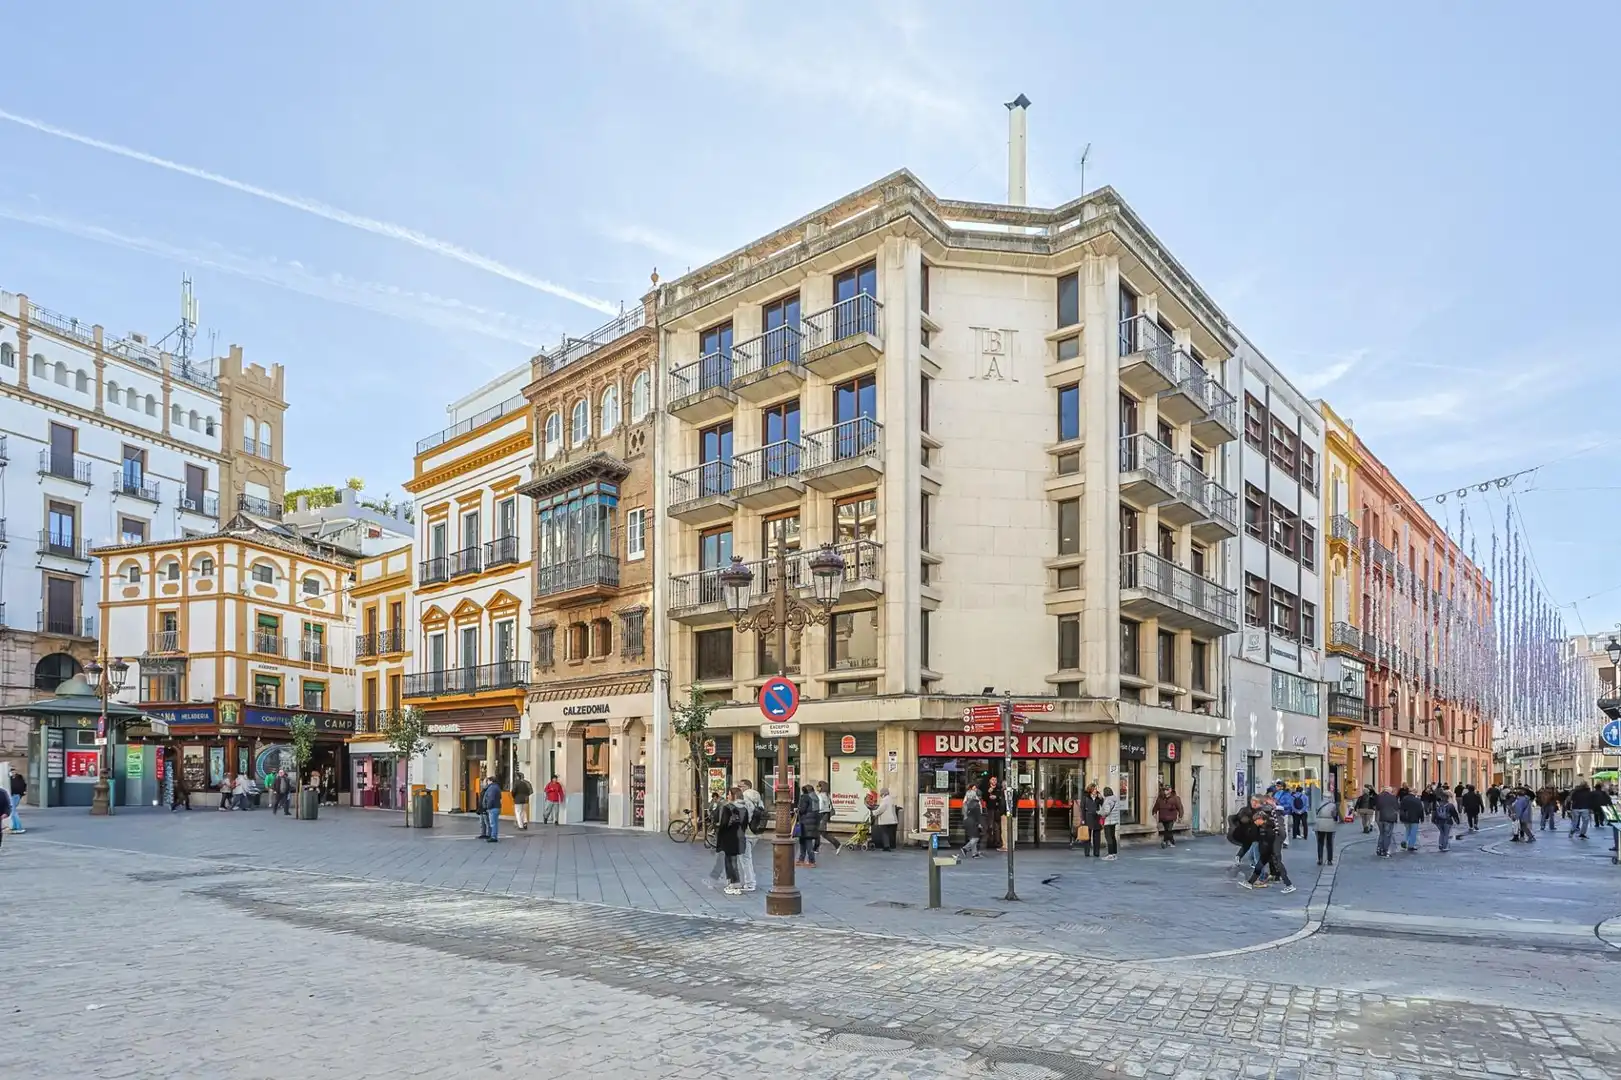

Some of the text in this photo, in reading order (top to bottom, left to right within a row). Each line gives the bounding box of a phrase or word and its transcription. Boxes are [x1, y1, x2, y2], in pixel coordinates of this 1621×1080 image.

[563, 703, 610, 716] CALZEDONIA
[935, 735, 1079, 753] BURGER KING
